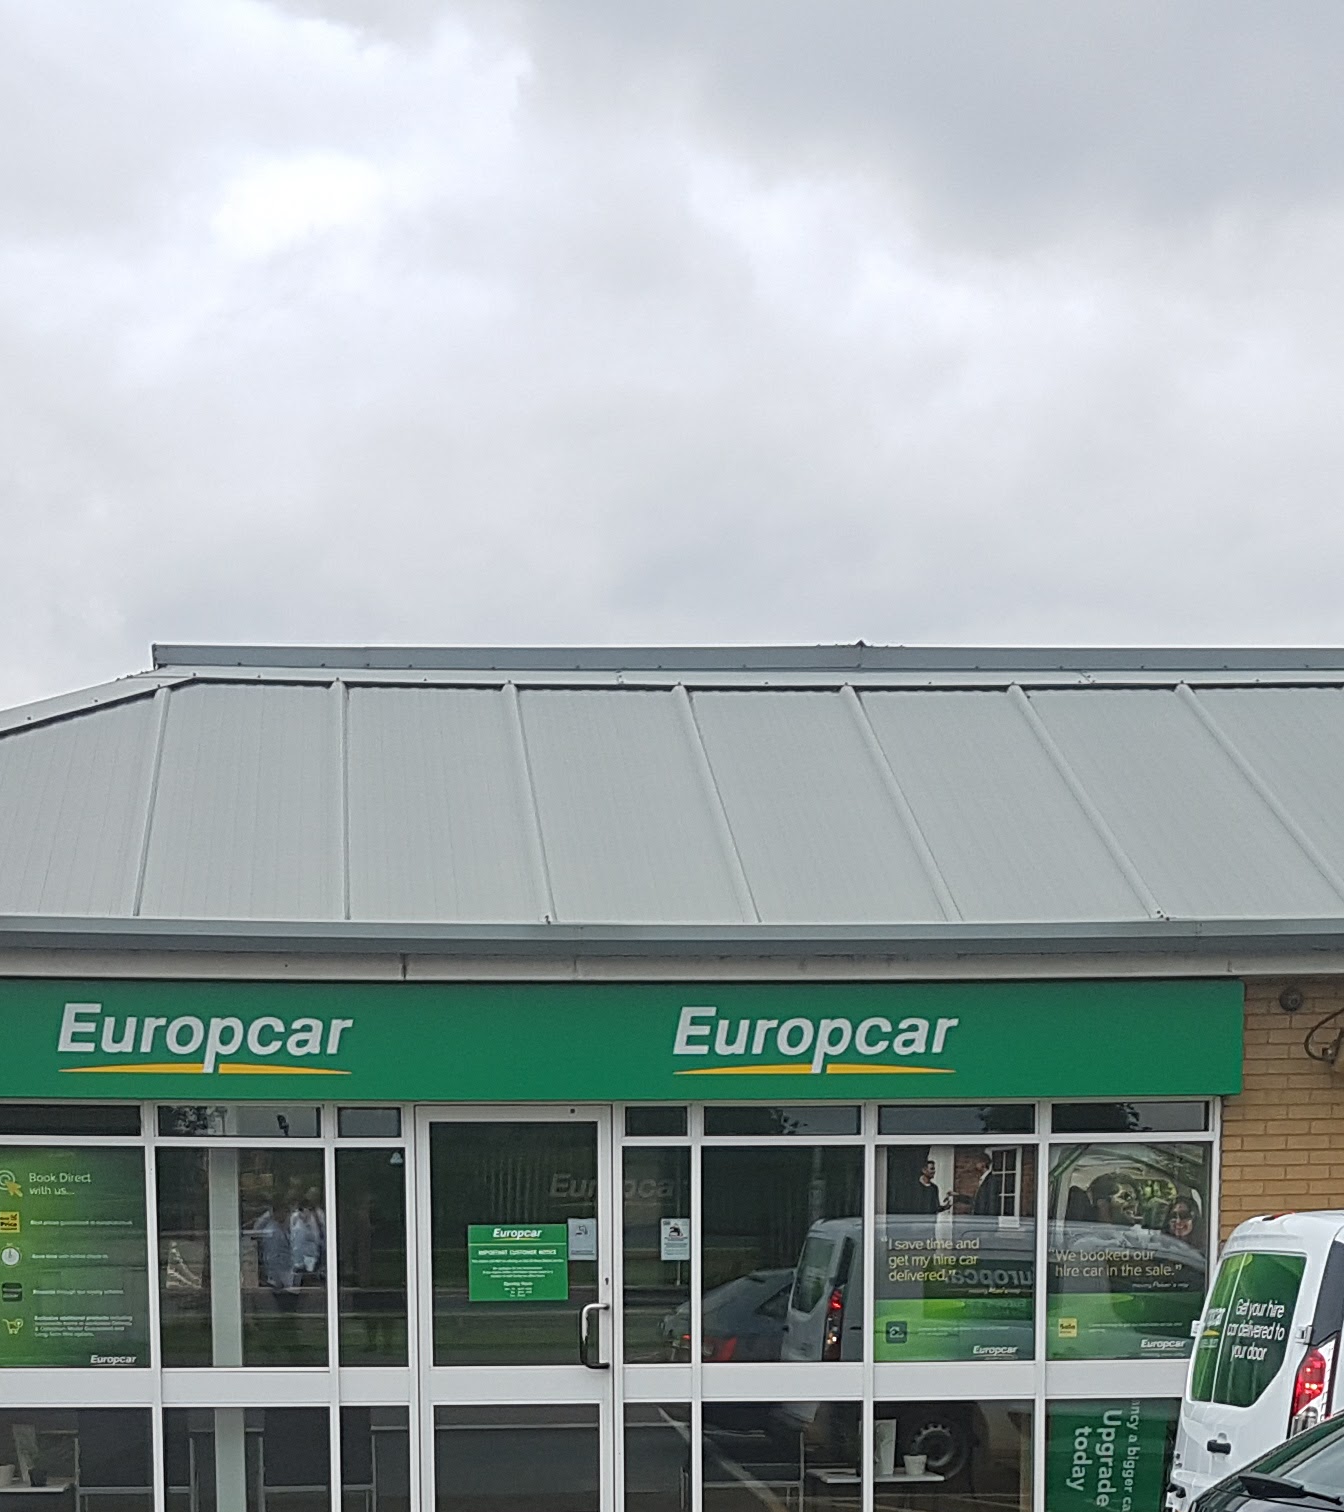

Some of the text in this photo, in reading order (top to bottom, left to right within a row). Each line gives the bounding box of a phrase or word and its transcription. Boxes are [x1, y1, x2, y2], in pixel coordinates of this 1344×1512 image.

[58, 1003, 353, 1073] Europcar
[673, 1006, 959, 1073] Europcar
[29, 1173, 91, 1183] Book Direct
[29, 1187, 51, 1195] with
[493, 1228, 542, 1240] Europcar
[894, 1239, 924, 1250] save
[926, 1238, 953, 1249] time
[956, 1237, 980, 1249] and
[888, 1253, 979, 1268] get my hire car
[1080, 1249, 1130, 1261] booked
[1133, 1250, 1155, 1261] our
[1055, 1265, 1079, 1277] hire
[1082, 1267, 1103, 1277] car
[1106, 1265, 1118, 1276] in
[1121, 1264, 1142, 1276] the
[1247, 1302, 1268, 1321] your
[1266, 1300, 1285, 1318] hire
[1238, 1320, 1274, 1340] delivered
[1274, 1322, 1286, 1341] to
[973, 1345, 1018, 1356] Europcar
[1141, 1339, 1186, 1350] Europcar
[1230, 1342, 1268, 1361] your door
[90, 1355, 137, 1365] Europcar
[1128, 1434, 1138, 1443] a
[1066, 1426, 1093, 1491] today
[1095, 1409, 1123, 1507] Upgrade
[1122, 1446, 1141, 1493] bigger
